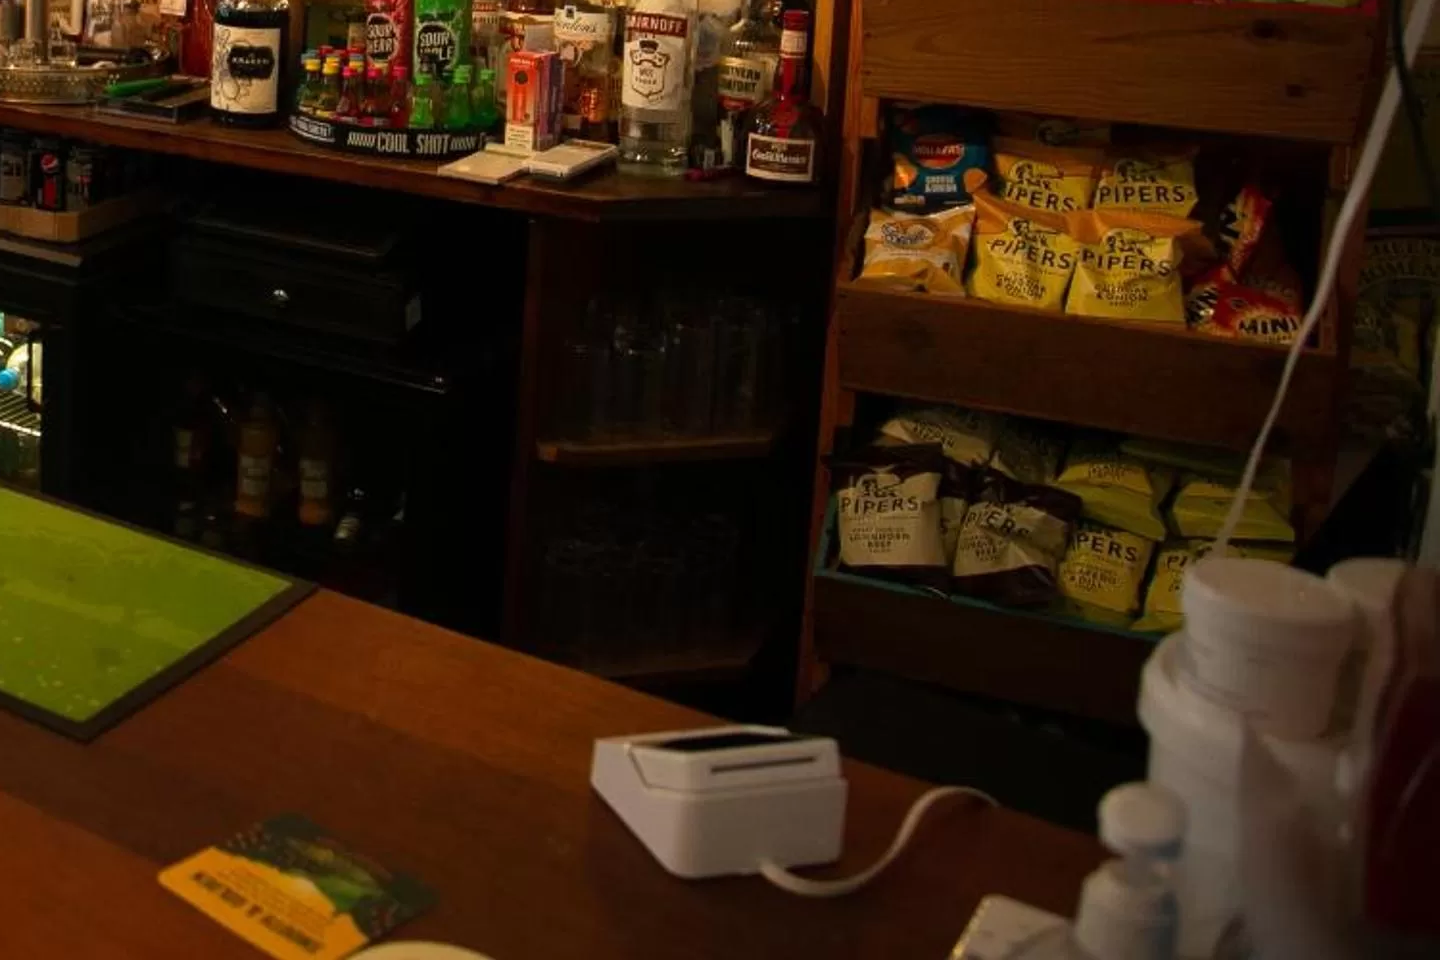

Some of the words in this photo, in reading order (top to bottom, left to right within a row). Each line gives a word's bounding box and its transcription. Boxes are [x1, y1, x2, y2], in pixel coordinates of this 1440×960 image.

[420, 31, 450, 48] SOUR
[1006, 187, 1075, 211] IPERS
[1099, 185, 1185, 204] PIPERS
[990, 239, 1072, 270] PIPERS
[1082, 248, 1172, 277] PIPERS
[1239, 316, 1299, 334] MINI
[841, 496, 919, 514] PIPERS
[1073, 532, 1138, 563] PERS
